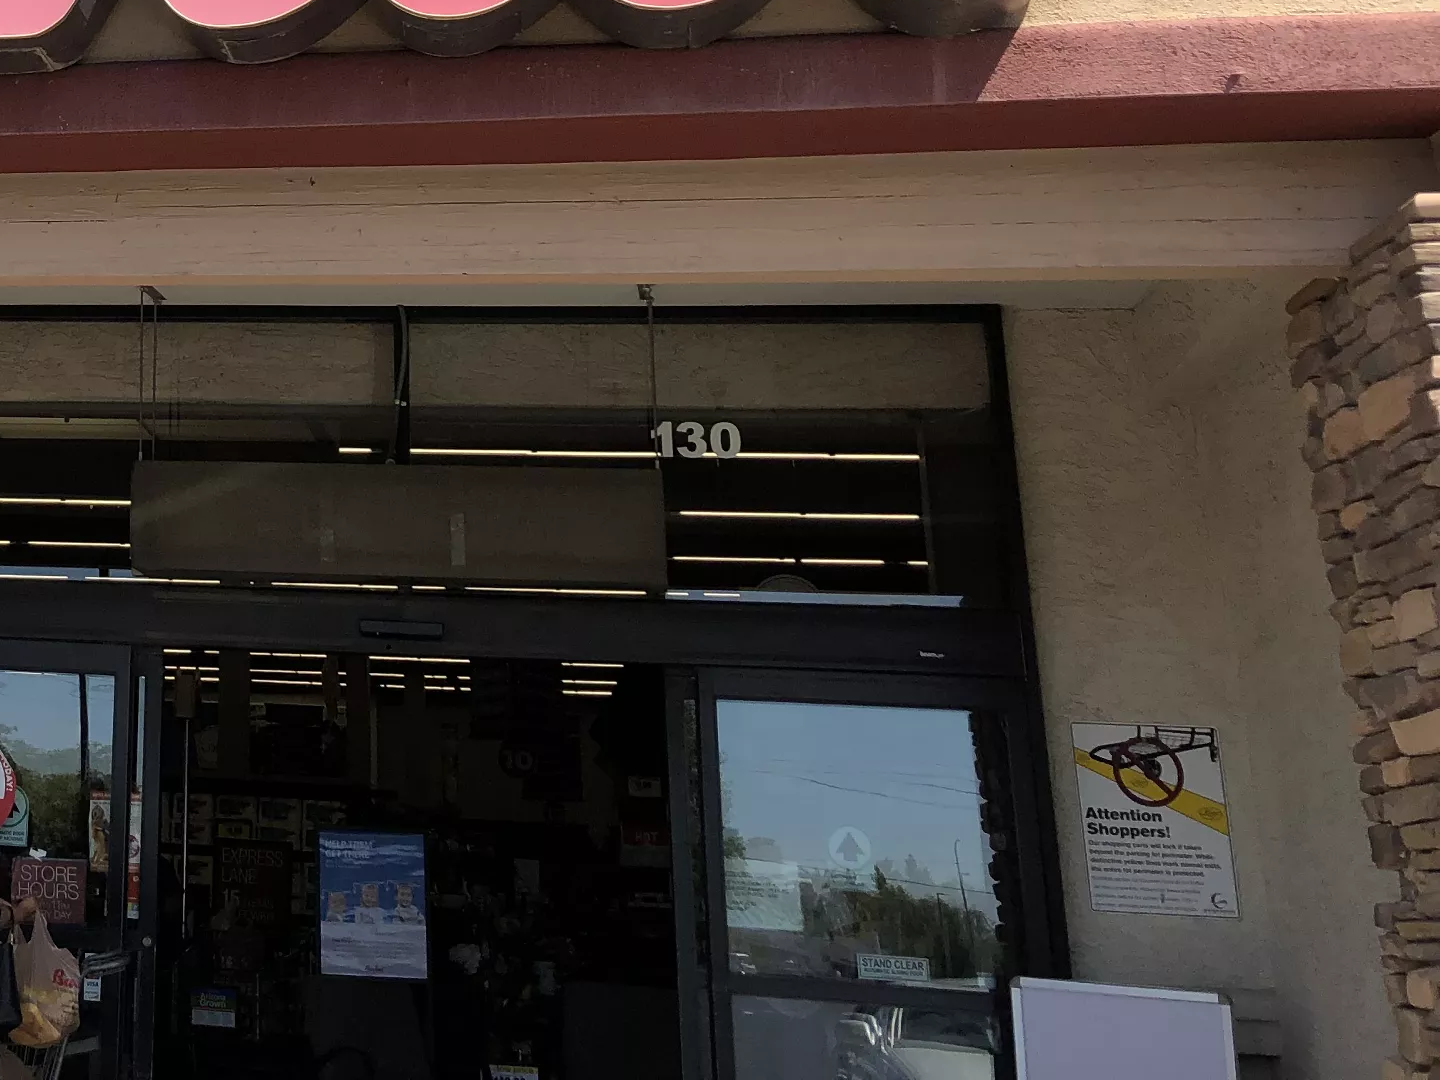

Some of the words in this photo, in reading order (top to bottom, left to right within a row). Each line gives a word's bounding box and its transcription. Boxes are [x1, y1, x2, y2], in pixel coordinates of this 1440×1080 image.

[650, 421, 742, 459] 130
[1085, 806, 1163, 822] Attention
[1087, 822, 1171, 839] Shoppers!
[221, 847, 284, 868] EXPRESS
[20, 864, 78, 883] STORE
[221, 865, 259, 885] LANE
[17, 881, 80, 900] HOURS
[861, 957, 892, 969] STAND
[893, 959, 925, 971] CLEAR
